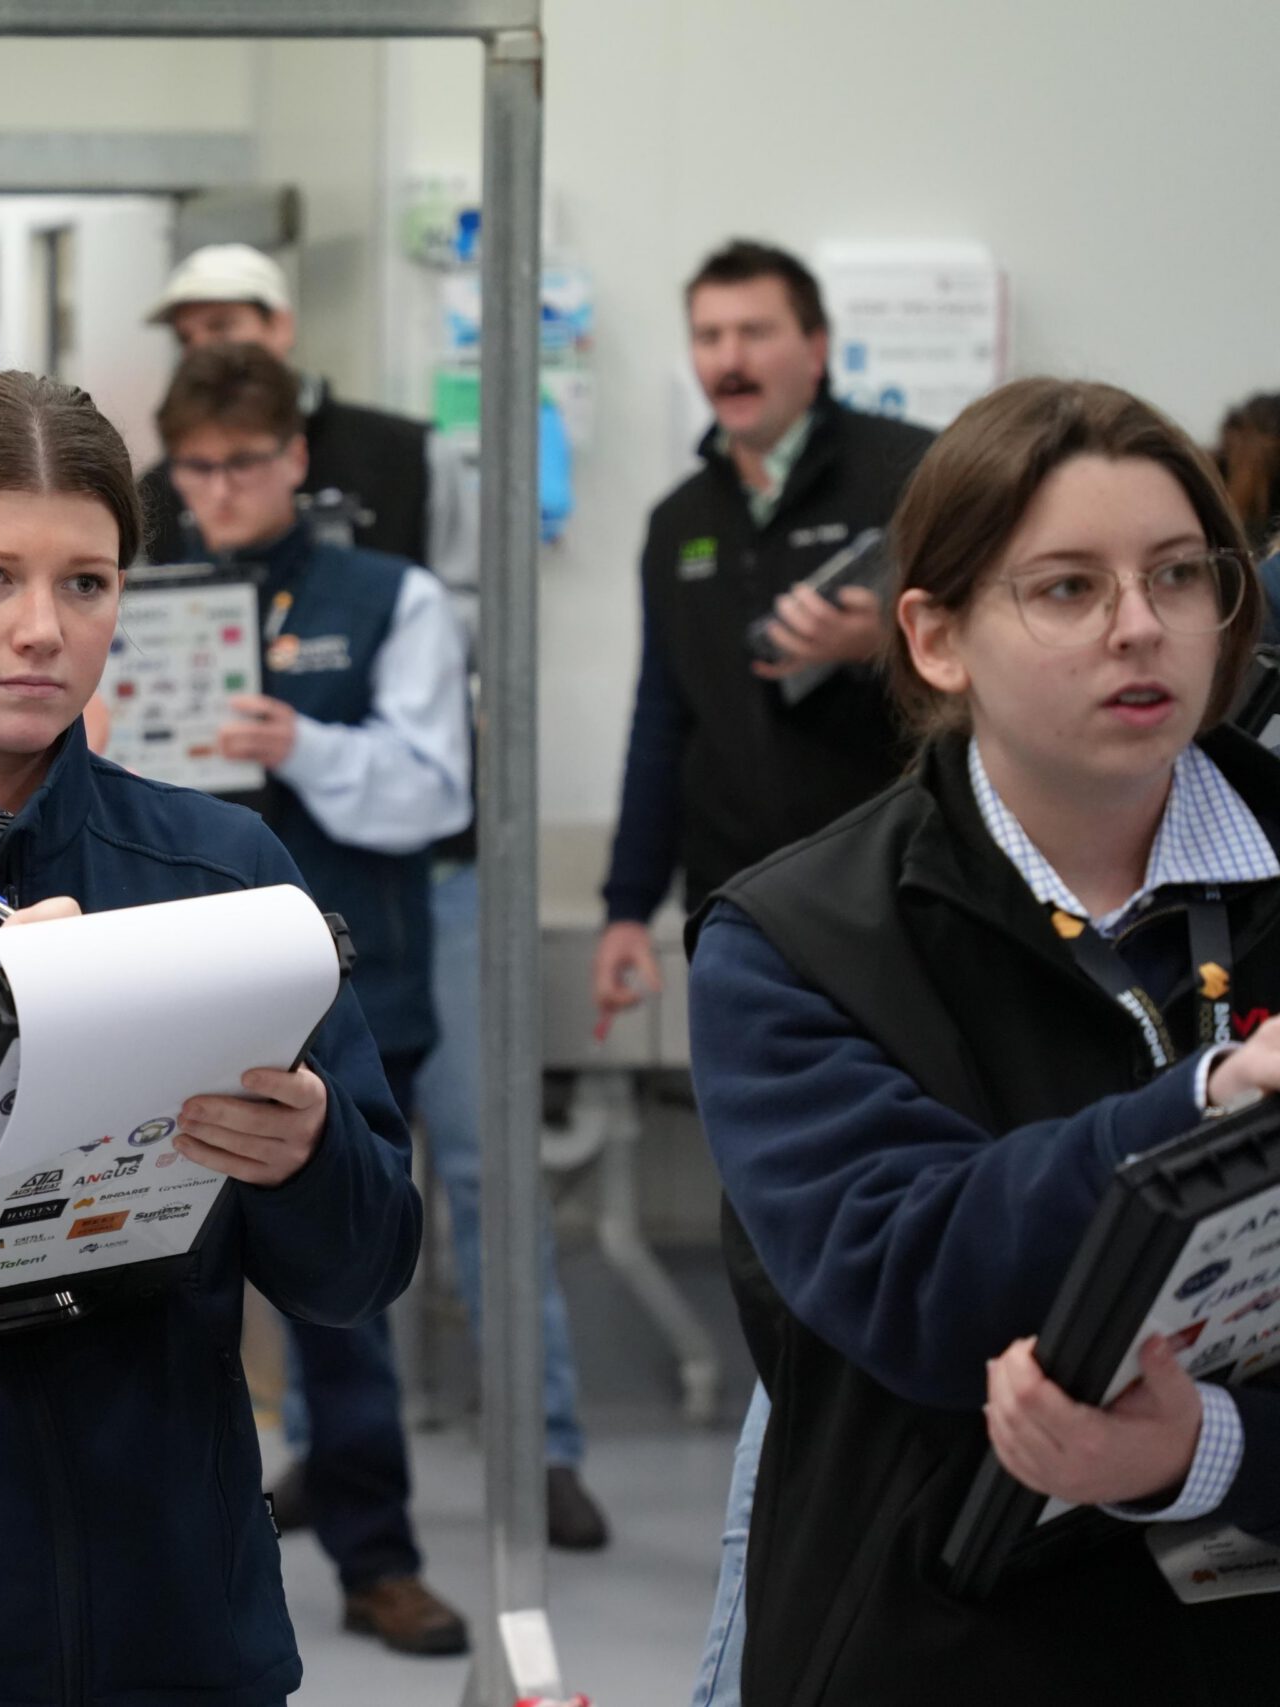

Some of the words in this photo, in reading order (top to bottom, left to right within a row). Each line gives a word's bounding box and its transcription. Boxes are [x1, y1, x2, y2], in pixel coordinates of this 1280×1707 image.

[72, 1165, 140, 1187] ANGUS
[159, 1178, 218, 1192] Greenham
[100, 1186, 151, 1201] BINDAREE
[159, 1211, 189, 1221] Group
[0, 1254, 47, 1269] Talent
